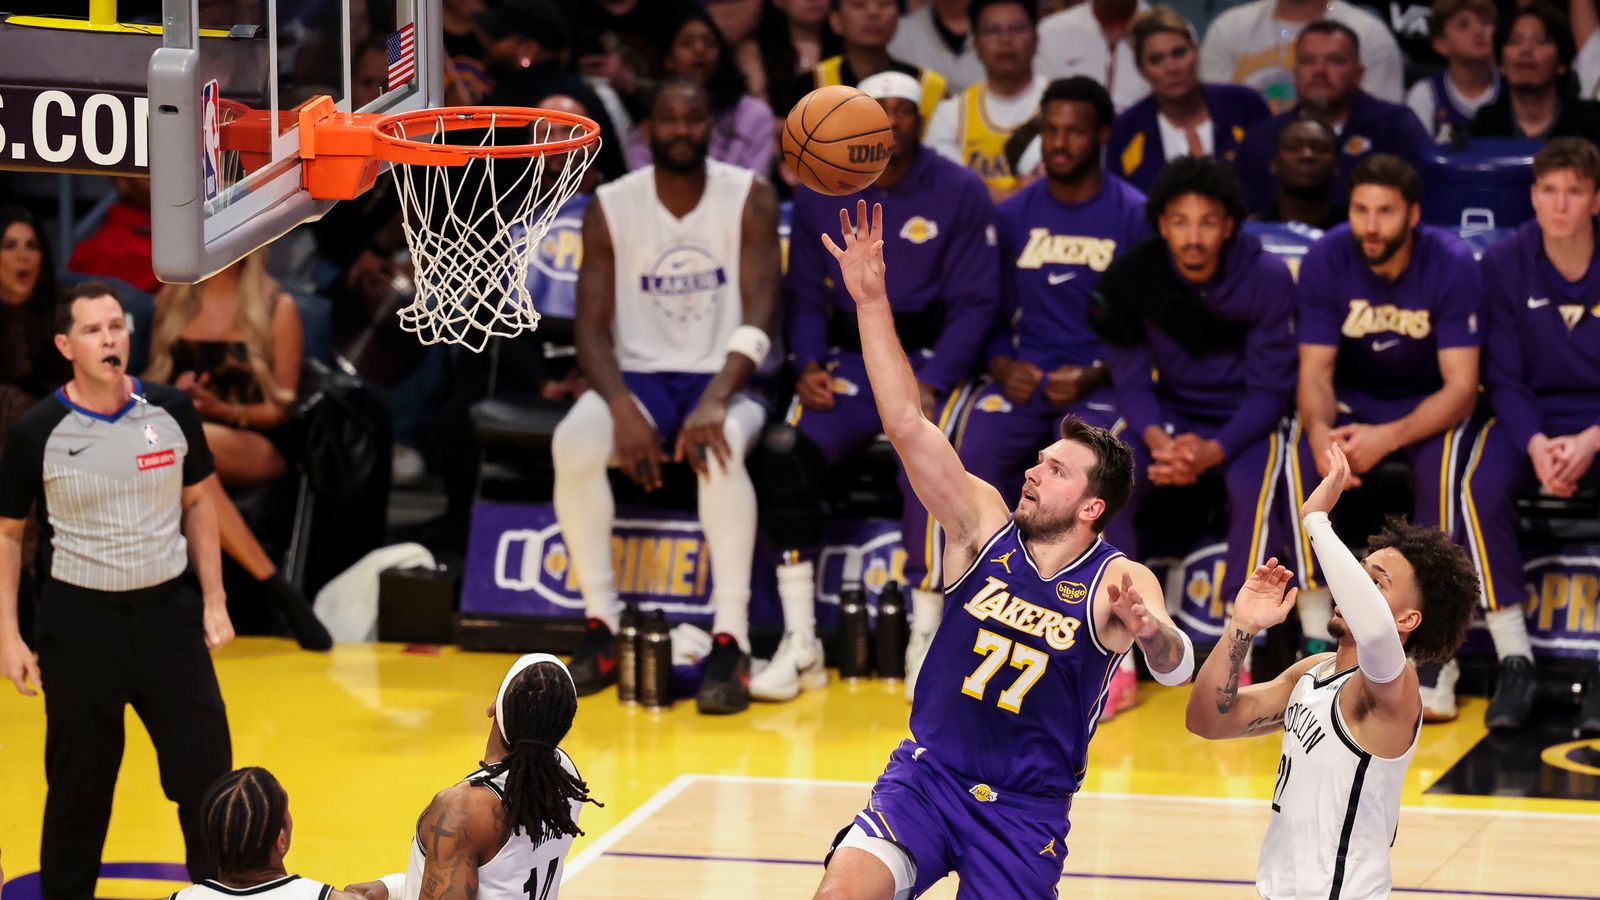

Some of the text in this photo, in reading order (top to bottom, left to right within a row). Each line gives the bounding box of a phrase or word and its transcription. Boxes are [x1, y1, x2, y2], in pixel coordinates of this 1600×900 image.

[0, 90, 149, 167] .CO
[963, 575, 1082, 650] LAKERS
[1058, 584, 1085, 598] bibigo
[1538, 572, 1600, 633] PR
[961, 628, 1050, 715] 77
